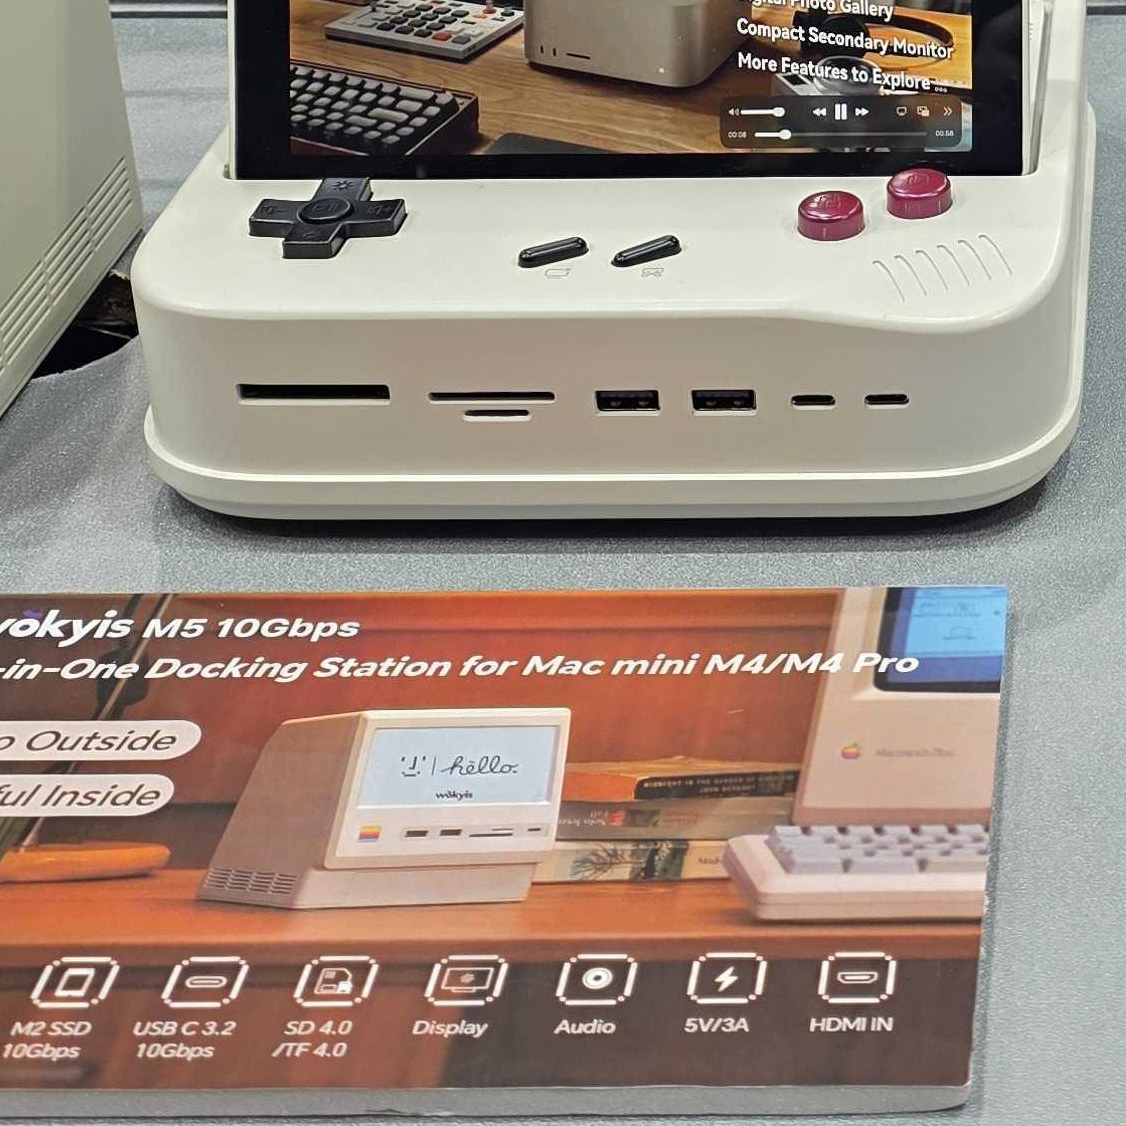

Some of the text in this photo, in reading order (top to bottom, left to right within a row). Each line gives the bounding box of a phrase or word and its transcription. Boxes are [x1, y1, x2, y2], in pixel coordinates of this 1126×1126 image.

[737, 18, 954, 58] Compact Secondary Monitor
[738, 52, 777, 70] More
[782, 57, 848, 81] Features
[851, 64, 867, 82] to
[873, 69, 930, 92] Explore
[143, 618, 205, 639] M5
[217, 618, 361, 643] 10Gbps
[145, 657, 306, 683] Docking
[312, 655, 451, 678] Station
[459, 654, 516, 677] for
[521, 655, 605, 676] Mac
[611, 653, 699, 675] mini
[703, 652, 842, 675] M4/M4
[852, 653, 920, 674] Pro
[25, 729, 177, 752] Outside
[42, 783, 162, 808] Inside
[11, 1021, 92, 1037] M2 SSD
[133, 1020, 237, 1036] USB C 3.2
[284, 1020, 353, 1036] SD 4.0
[412, 1020, 489, 1038] Display
[554, 1019, 616, 1035] Audio
[684, 1017, 750, 1033] 5V/3A
[809, 1017, 894, 1032] HDMI IN
[2, 1043, 81, 1060] 10Gbps
[136, 1043, 215, 1060] 10Gbps
[272, 1043, 348, 1059] /TF 4.0
